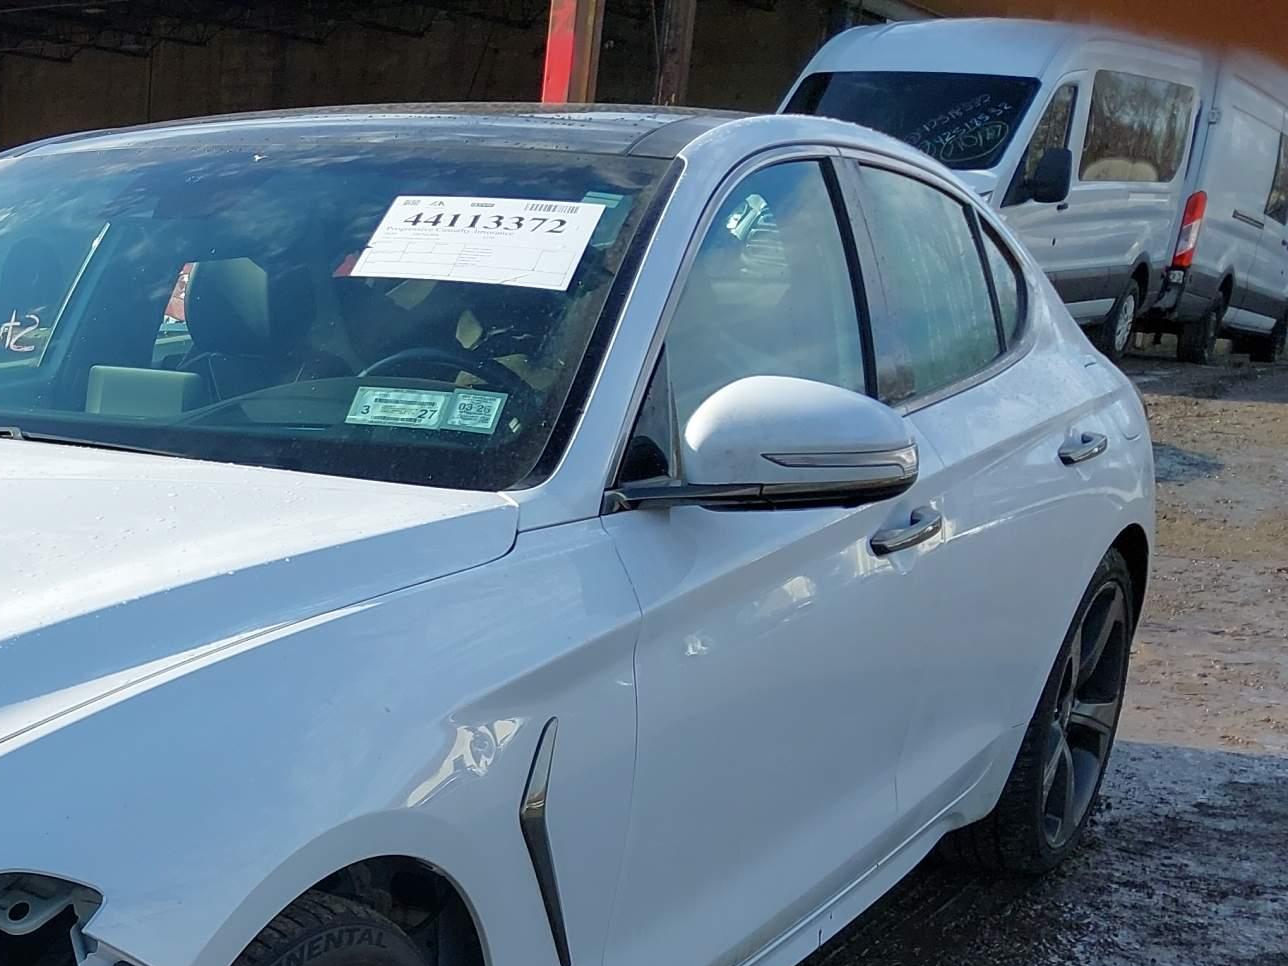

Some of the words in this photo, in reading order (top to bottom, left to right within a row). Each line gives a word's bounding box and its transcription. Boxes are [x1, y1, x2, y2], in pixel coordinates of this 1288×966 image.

[403, 212, 567, 233] 44113372
[361, 405, 370, 414] 3
[418, 409, 437, 420] 27
